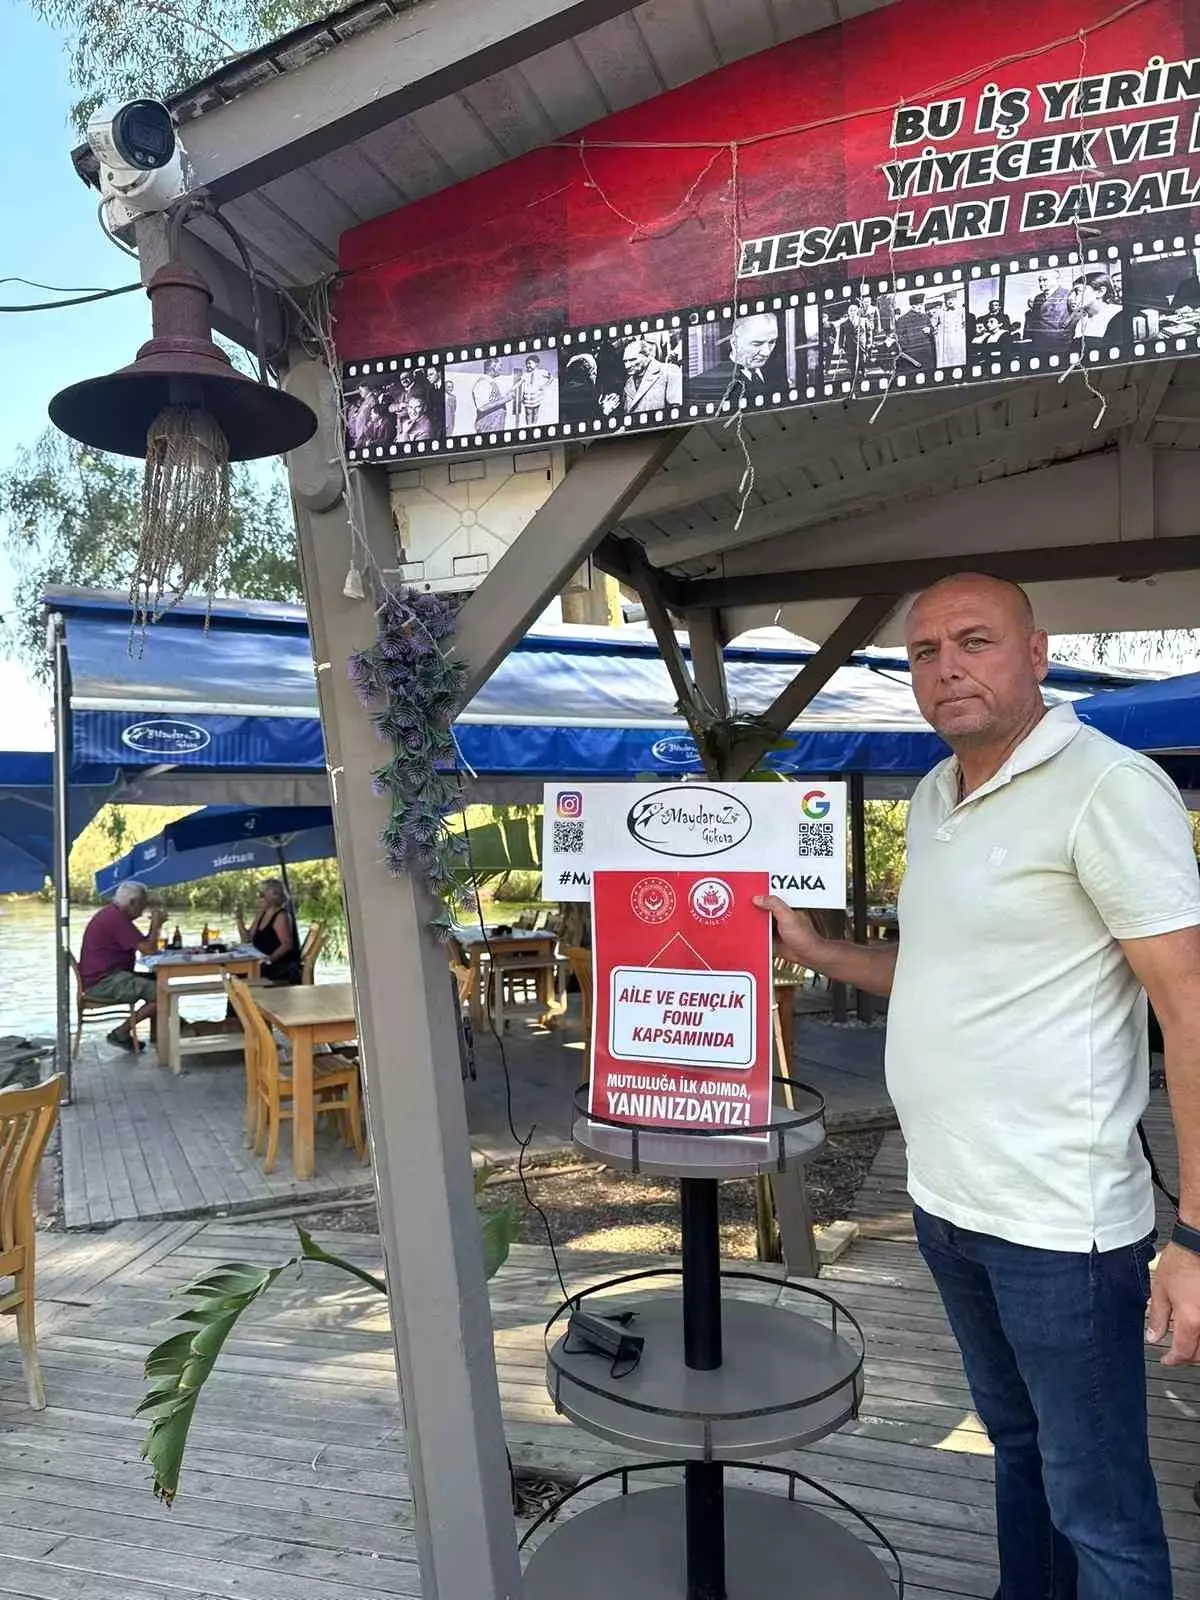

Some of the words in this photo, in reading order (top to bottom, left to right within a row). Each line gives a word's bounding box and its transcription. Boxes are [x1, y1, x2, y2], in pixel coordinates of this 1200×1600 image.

[890, 98, 964, 149] BU
[975, 83, 1030, 139] İŞ
[882, 127, 1103, 200] YİYECEK
[1105, 116, 1179, 165] VE
[735, 196, 1010, 279] HESAPLARI
[1019, 167, 1200, 232] BABAL
[618, 985, 653, 1004] AİLE
[656, 989, 676, 1005] VE
[678, 990, 746, 1012] GENÇLİK
[662, 1010, 704, 1027] FONU
[631, 1026, 735, 1048] KAPSAMINDA
[606, 1073, 677, 1092] MUTLULUĞA
[679, 1076, 698, 1094] İLK
[699, 1080, 752, 1101] ADIMDA,
[606, 1091, 751, 1127] YANINIZDAYIZ!
